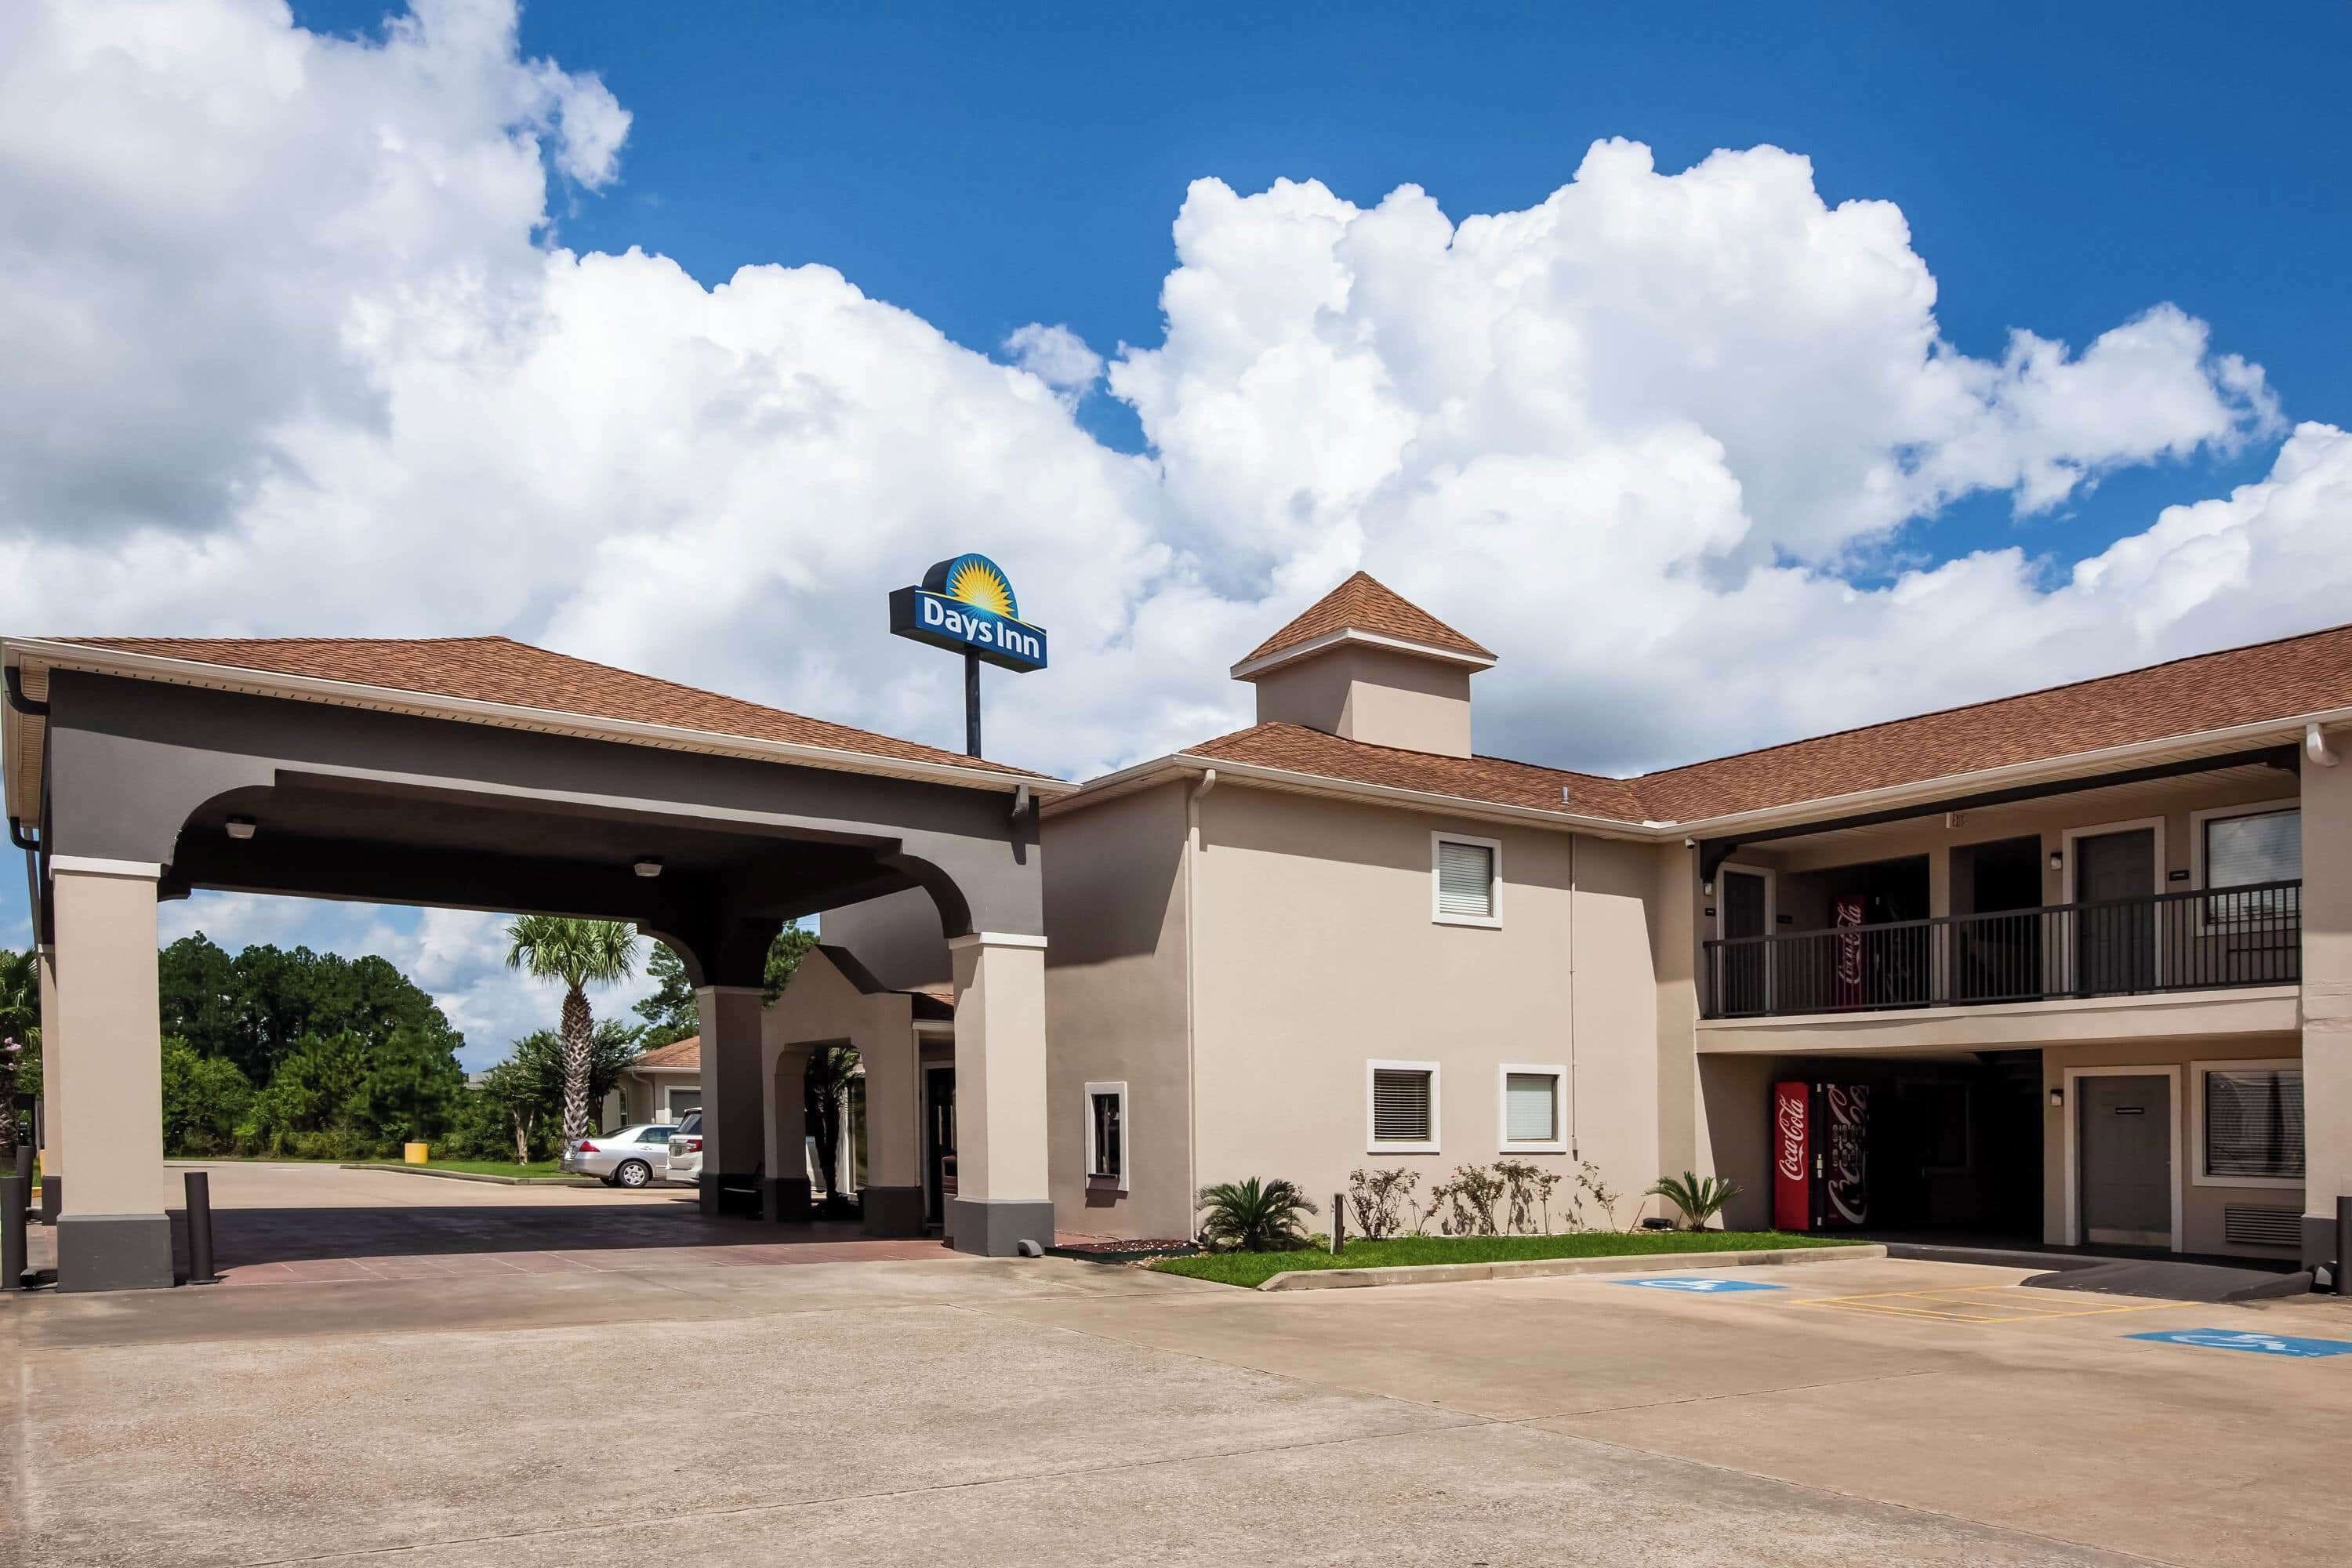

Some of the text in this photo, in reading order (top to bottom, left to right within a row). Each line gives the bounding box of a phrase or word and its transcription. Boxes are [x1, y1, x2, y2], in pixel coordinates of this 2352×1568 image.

[924, 597, 1040, 659] Days Inn
[1779, 1094, 1804, 1181] Coca-Cola
